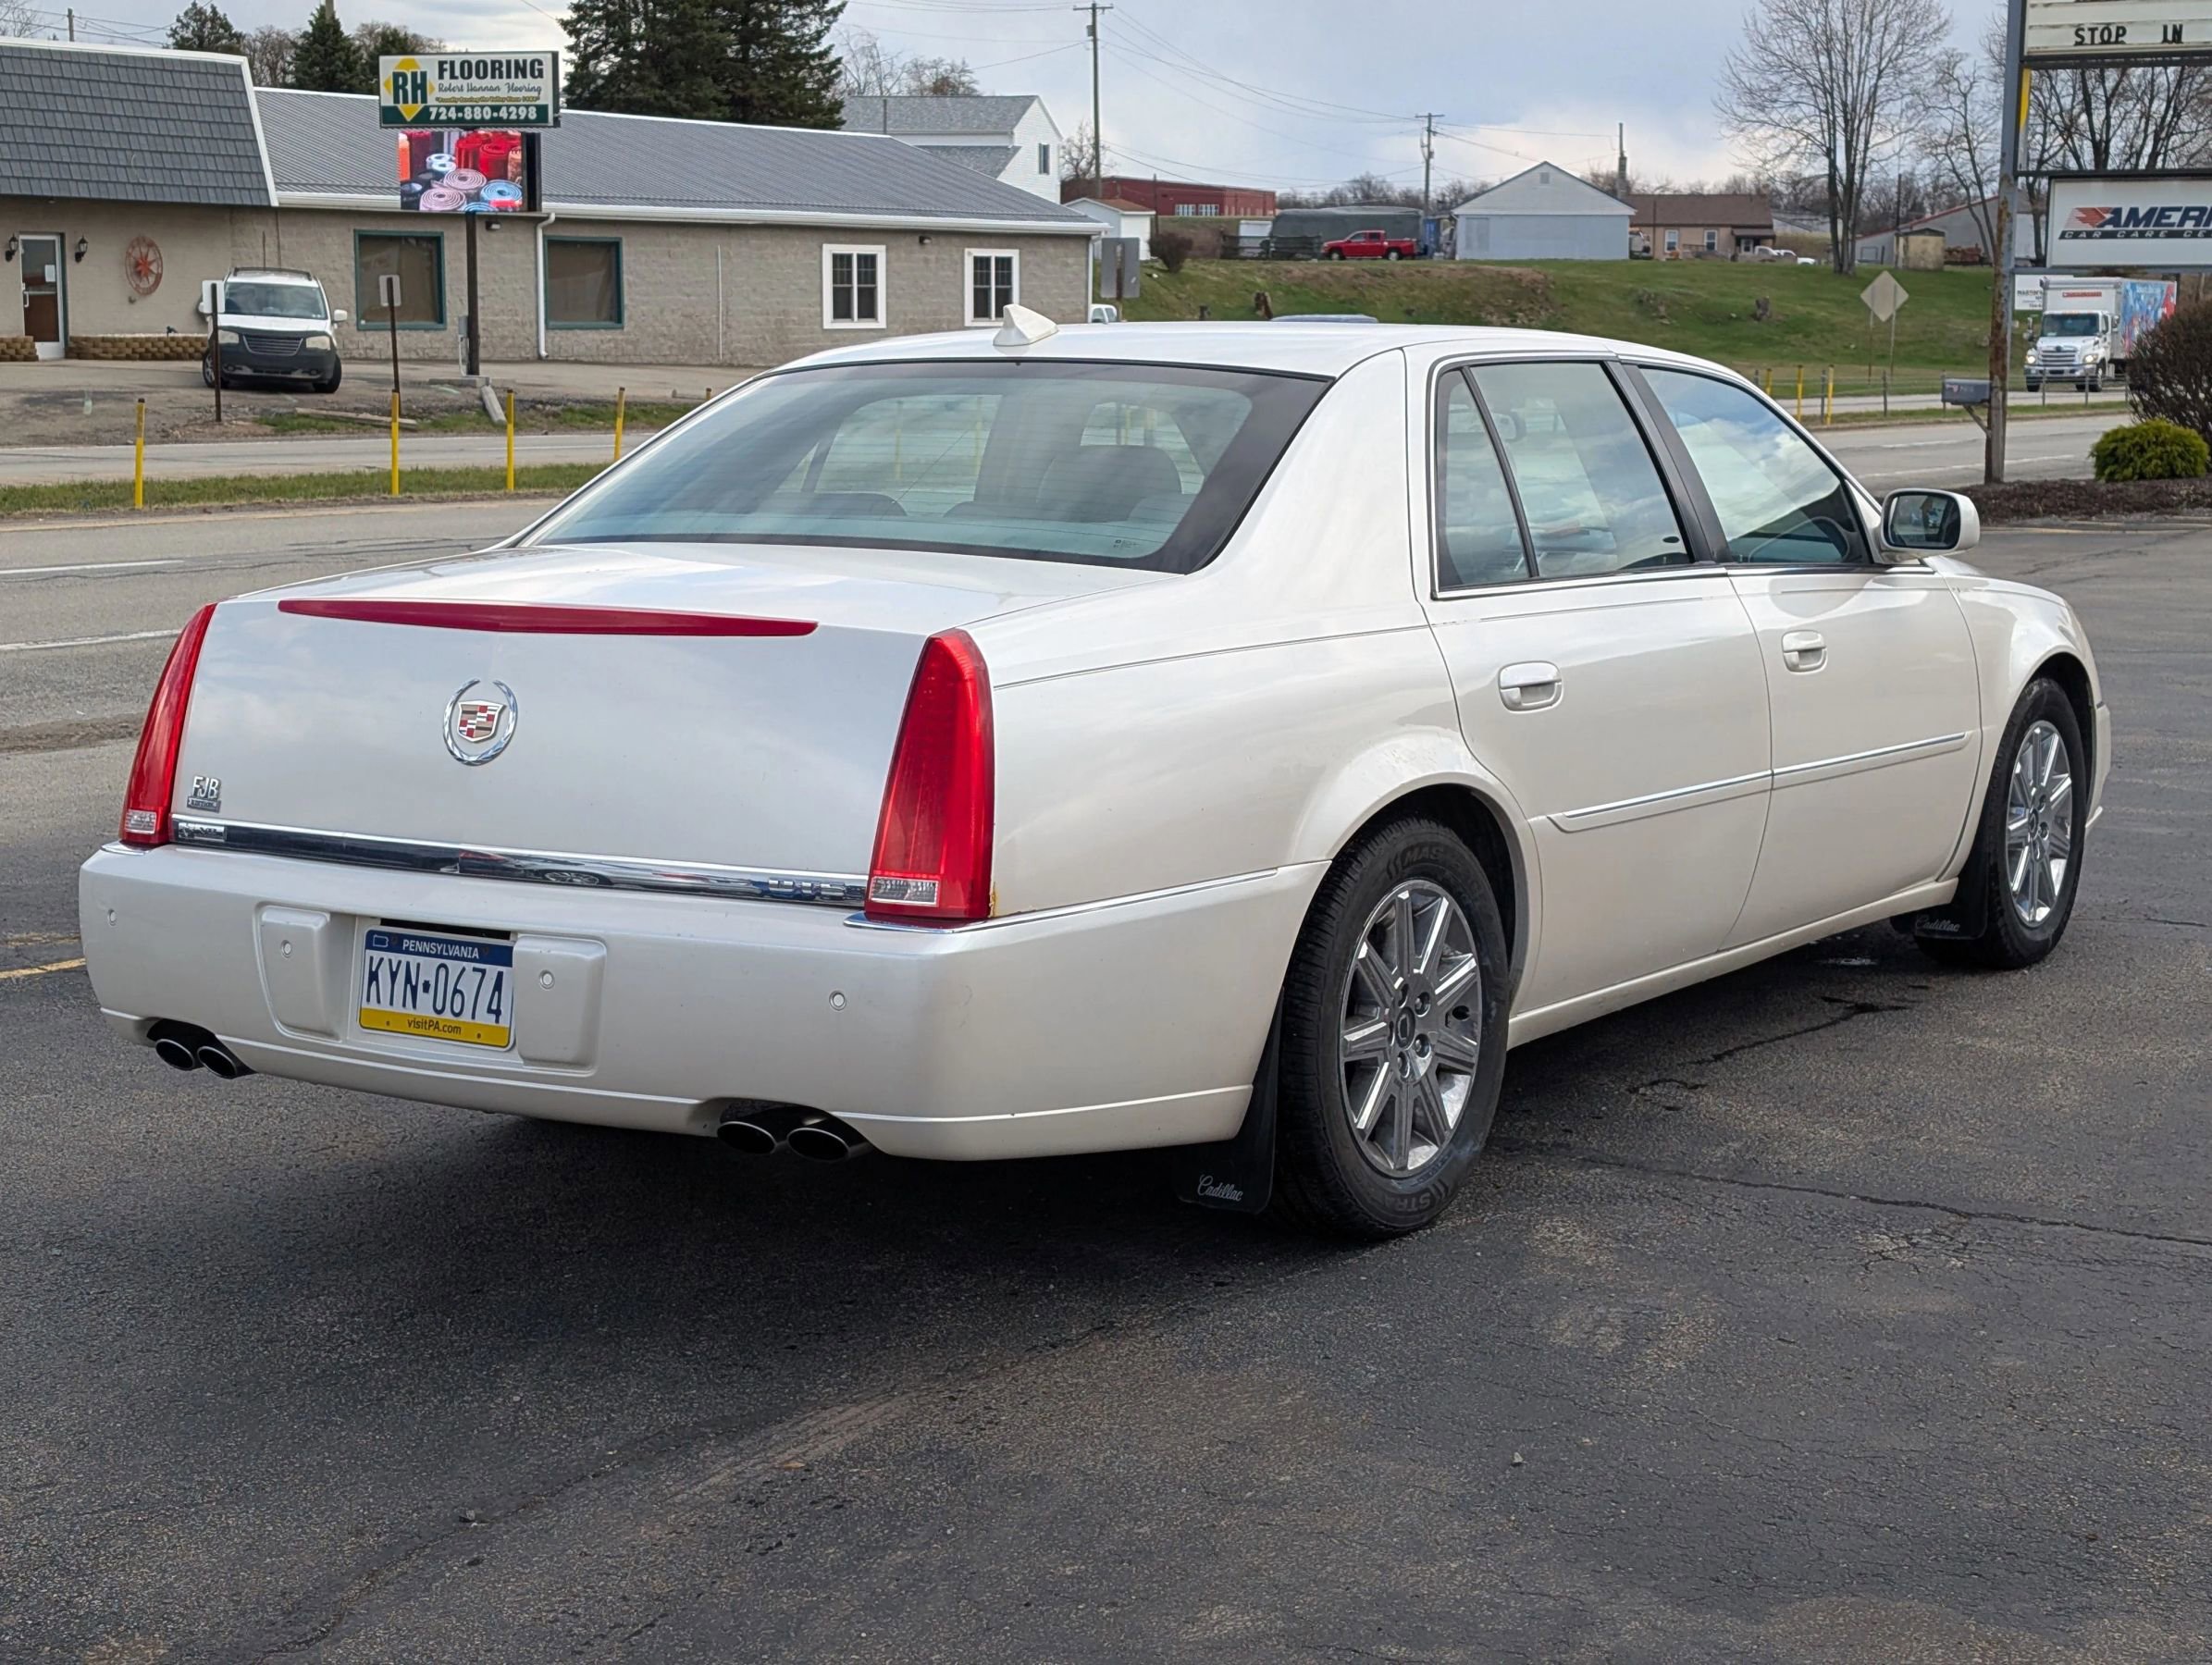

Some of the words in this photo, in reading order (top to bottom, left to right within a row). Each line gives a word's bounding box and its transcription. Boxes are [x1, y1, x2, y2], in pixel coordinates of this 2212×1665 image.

[2074, 26, 2127, 45] STOP
[2162, 24, 2183, 43] IN
[438, 58, 544, 80] FLOORING
[392, 71, 427, 104] RH
[438, 82, 464, 93] Robert
[466, 82, 501, 93] Hannan
[505, 82, 542, 96] Flooring
[428, 105, 538, 121] 724-880-4298
[2064, 230, 2102, 239] CAR
[2117, 230, 2168, 239] CARE
[2183, 230, 2212, 239] CE
[192, 775, 219, 799] FJB
[1915, 913, 1961, 933] Cadillac
[402, 938, 479, 959] PENNSYLVANIA
[407, 1018, 462, 1035] visitPA.com
[1197, 1174, 1243, 1202] Cadillac
